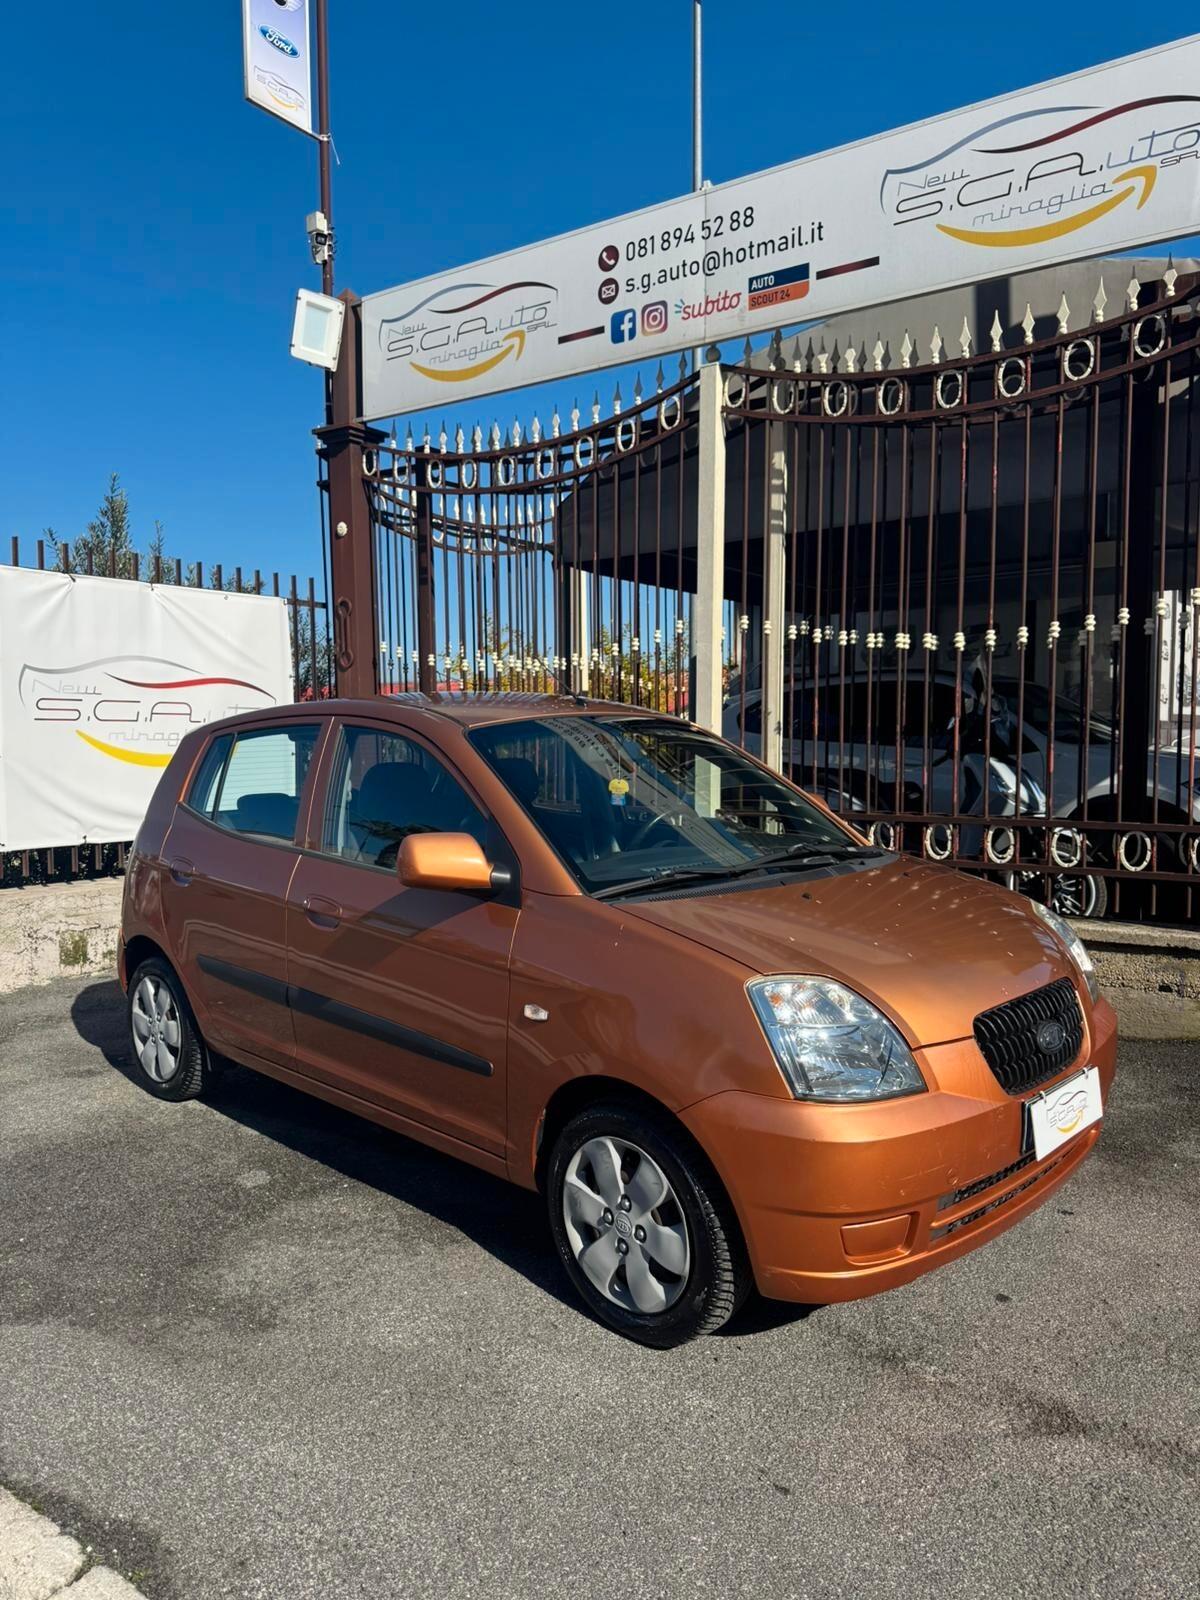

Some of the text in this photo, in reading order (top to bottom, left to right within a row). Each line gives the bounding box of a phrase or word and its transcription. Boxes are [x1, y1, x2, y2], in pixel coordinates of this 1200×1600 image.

[266, 28, 293, 54] Ford
[898, 168, 970, 196] New
[972, 181, 1112, 227] miraglia
[626, 206, 755, 261] 081 894 52 88
[625, 220, 824, 294] s.g.auto@hotmail.it
[751, 275, 775, 290] AUTO
[681, 290, 742, 321] subito
[387, 322, 428, 339] New
[429, 338, 503, 366] miraglia
[32, 679, 102, 696] New
[108, 728, 186, 747] mirag
